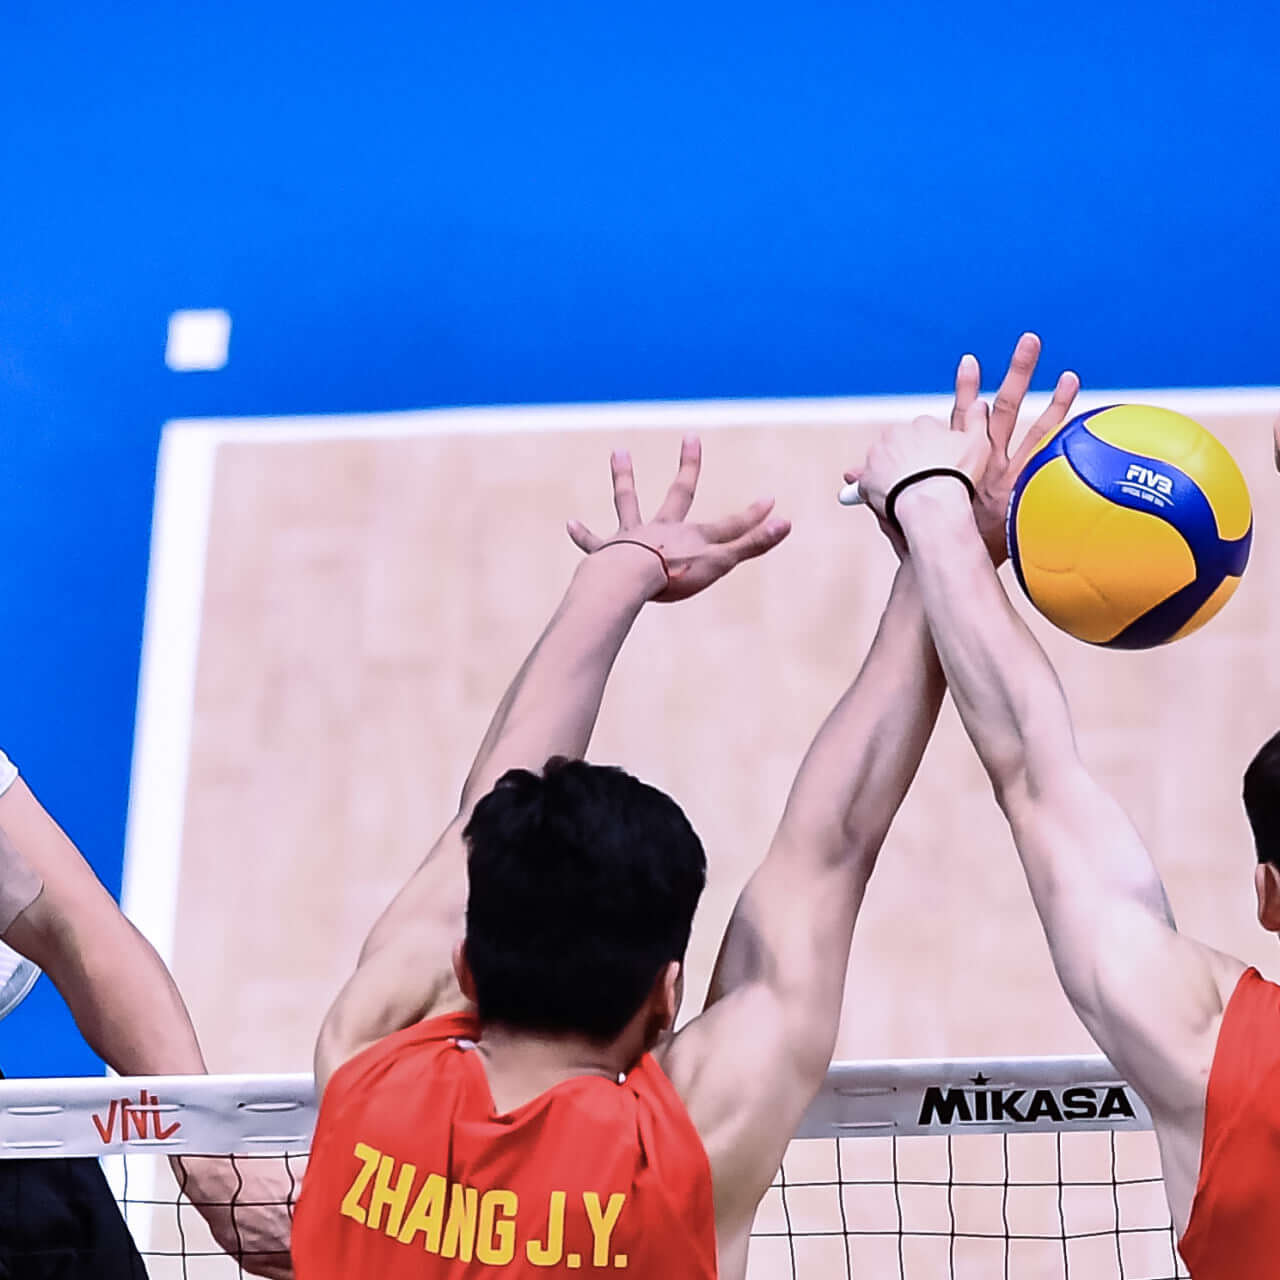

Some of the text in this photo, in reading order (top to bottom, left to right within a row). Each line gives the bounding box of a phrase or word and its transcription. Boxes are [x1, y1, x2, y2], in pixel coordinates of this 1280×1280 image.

[1125, 464, 1173, 497] FIVB
[918, 1078, 1137, 1126] MIKASA
[340, 1142, 629, 1268] ZHANG J.Y.
